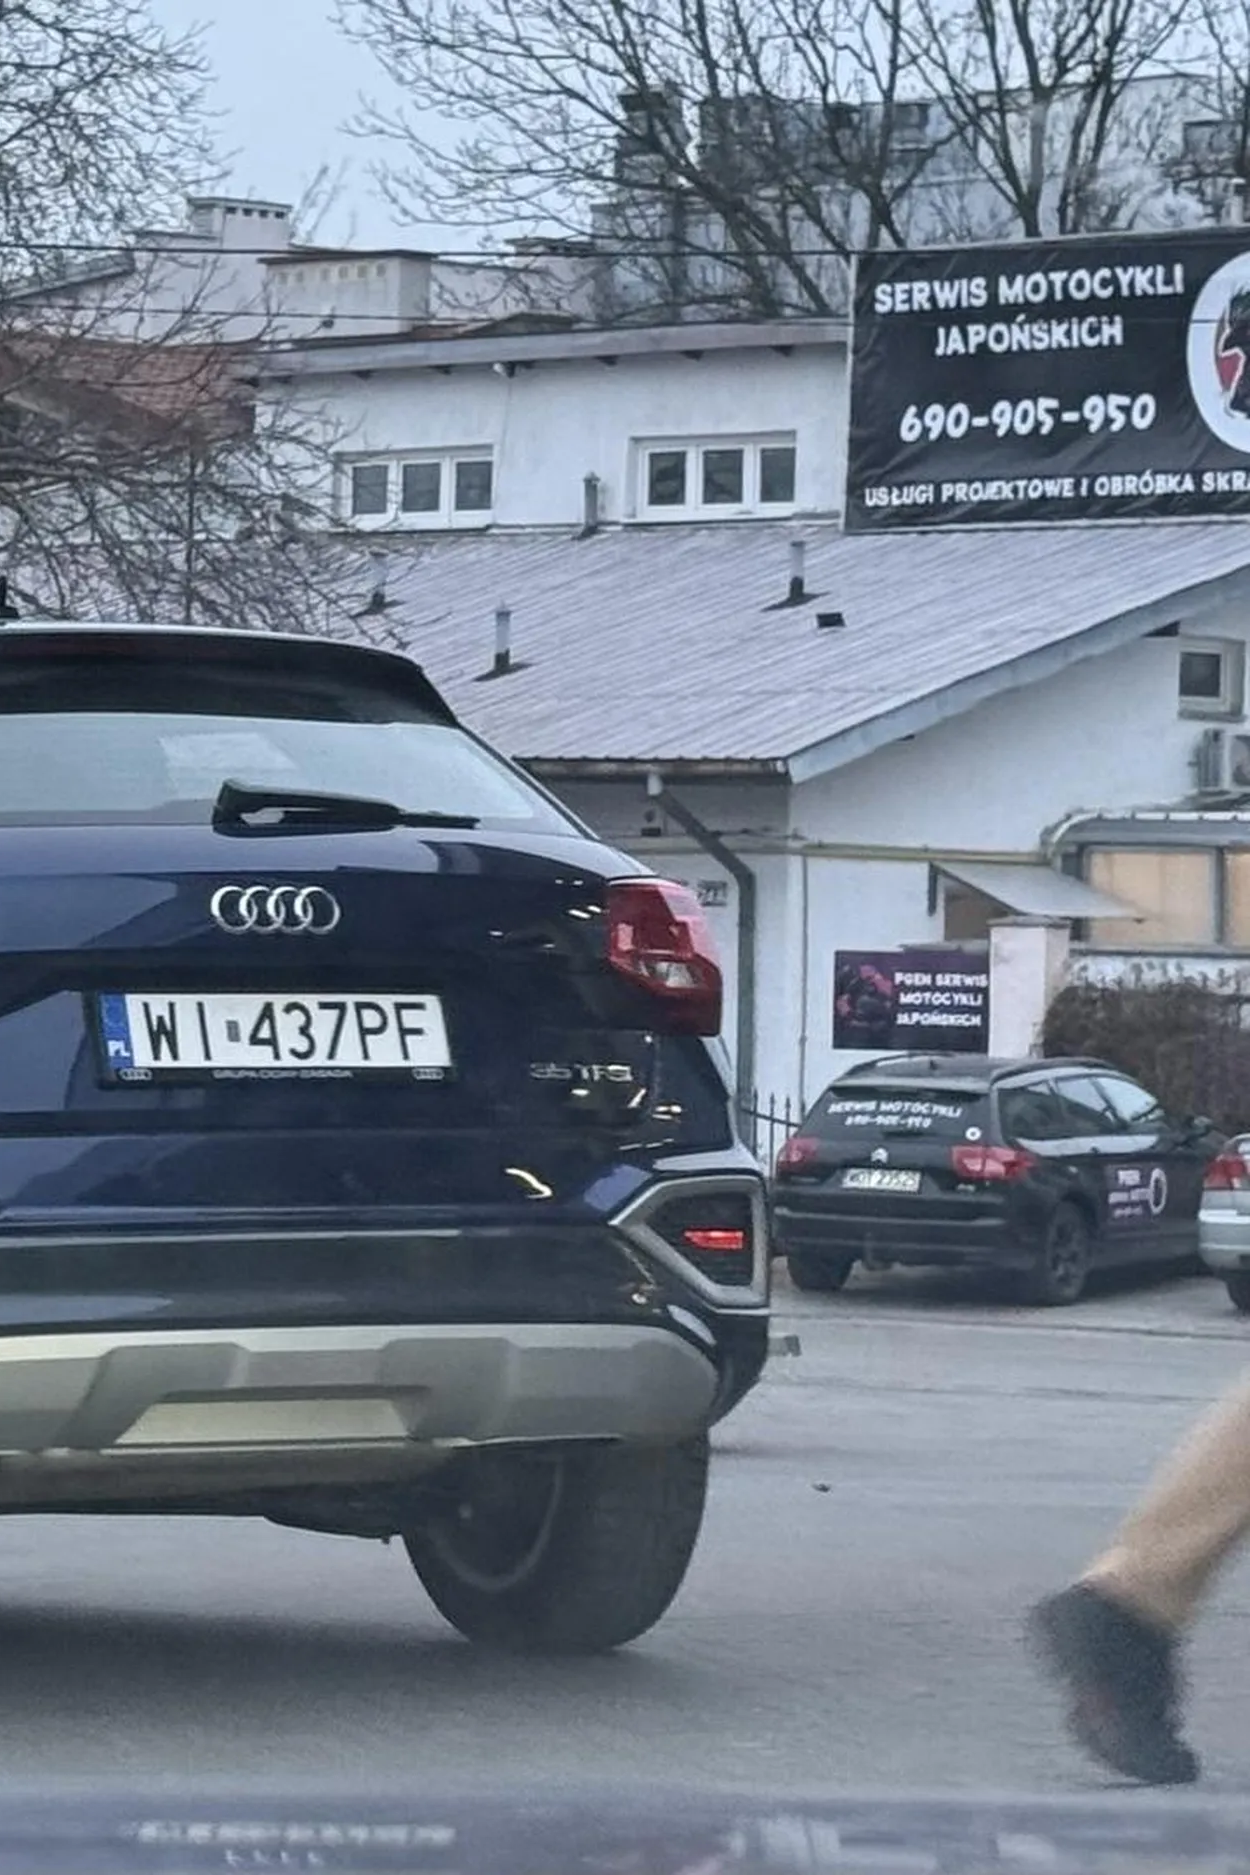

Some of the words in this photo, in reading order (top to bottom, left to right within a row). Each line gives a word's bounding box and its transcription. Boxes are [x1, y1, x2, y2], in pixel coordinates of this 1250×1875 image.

[873, 276, 987, 314] SERWIS
[998, 263, 1184, 305] MOTOCYKLI
[935, 314, 1123, 356] JAPOŃSKICH
[899, 393, 1156, 443] 690-905-950
[865, 482, 934, 507] USŁUGI
[940, 476, 1075, 504] PROJEKTOWE
[1080, 478, 1089, 496] I
[1094, 469, 1194, 497] OBRÓBKA
[899, 991, 983, 1007] MOTOCYKLI
[935, 972, 989, 988] SERWIS
[142, 1001, 212, 1061] WI
[249, 1001, 427, 1061] 437PF
[896, 1009, 982, 1027] JAPOŃSKICH
[108, 1040, 130, 1056] PL
